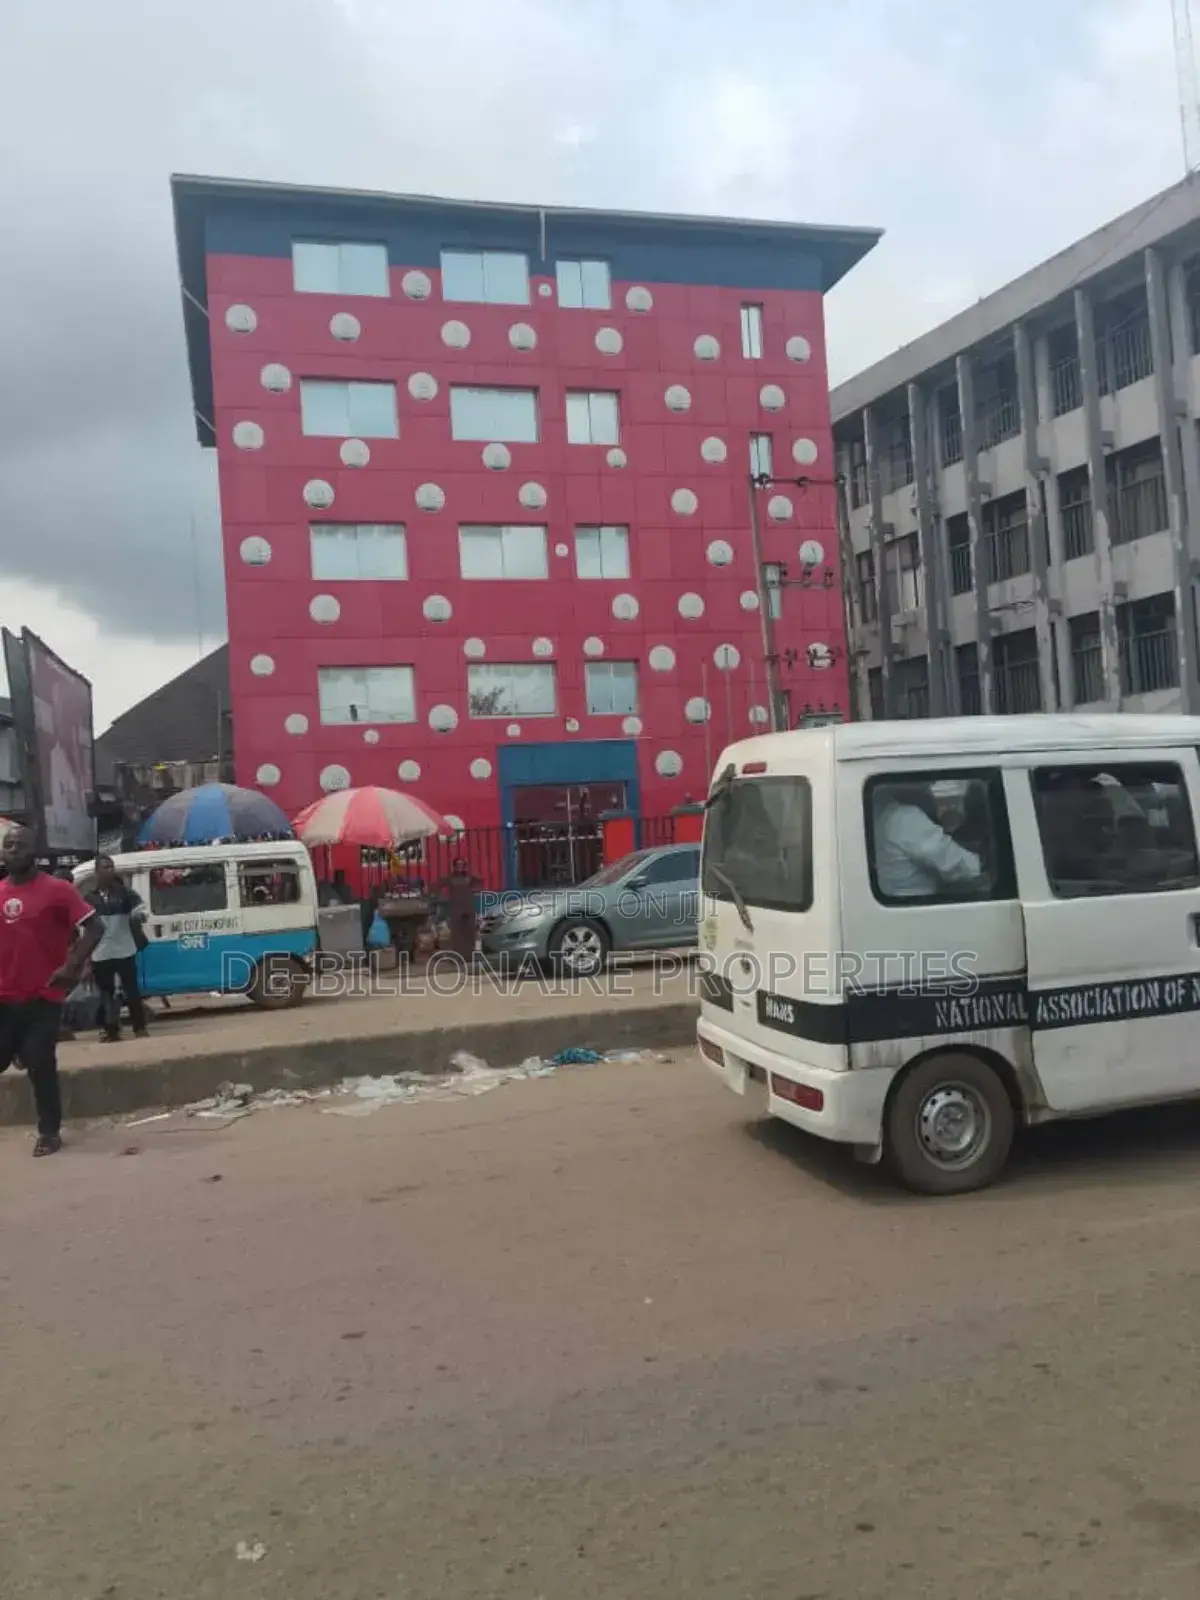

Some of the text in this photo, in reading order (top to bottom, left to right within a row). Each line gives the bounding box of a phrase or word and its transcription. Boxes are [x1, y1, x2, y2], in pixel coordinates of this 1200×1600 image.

[934, 992, 1030, 1028] NATIONAL
[1036, 980, 1160, 1023] ASSOCIATION
[1163, 978, 1187, 1008] OF
